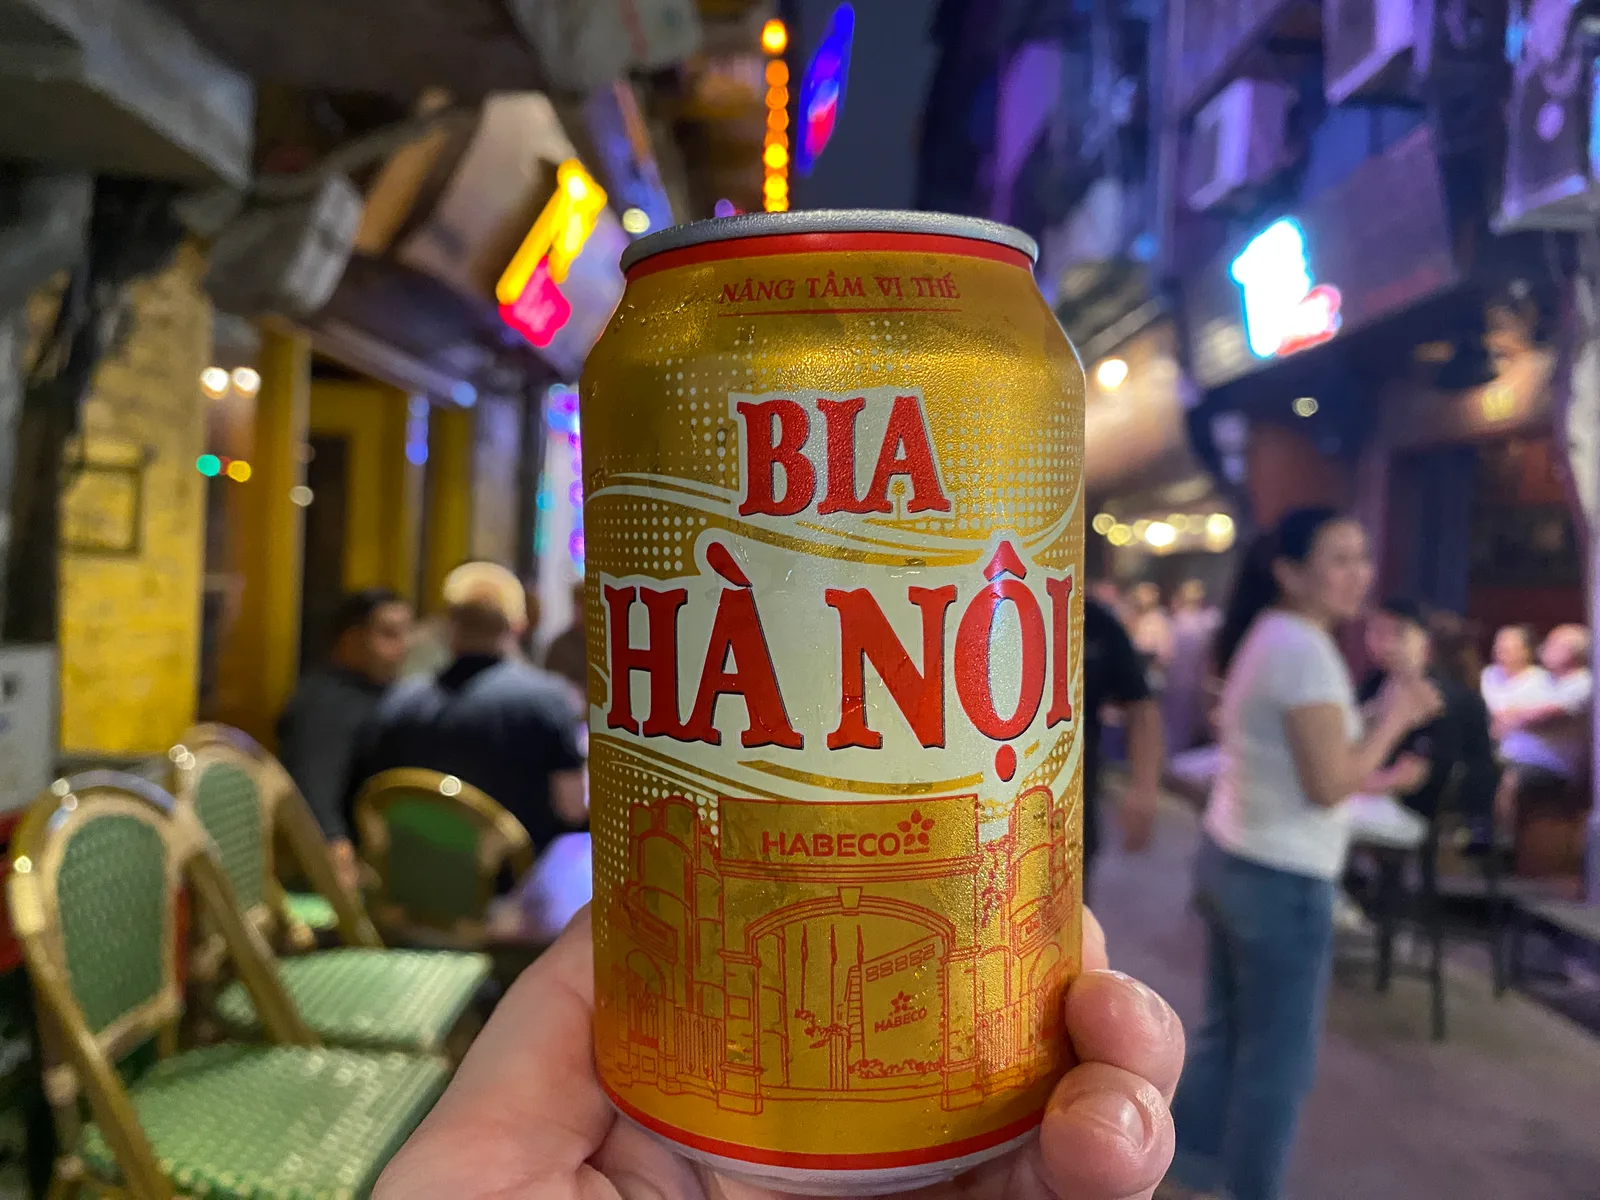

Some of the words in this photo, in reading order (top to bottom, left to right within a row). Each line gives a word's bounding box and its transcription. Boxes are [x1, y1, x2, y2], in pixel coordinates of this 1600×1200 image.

[719, 277, 796, 304] NÂNG
[736, 395, 952, 517] BIA
[604, 541, 805, 750] HÀ
[824, 540, 1074, 783] NỘI
[762, 831, 900, 857] HABECO
[874, 1007, 928, 1034] HABECO
